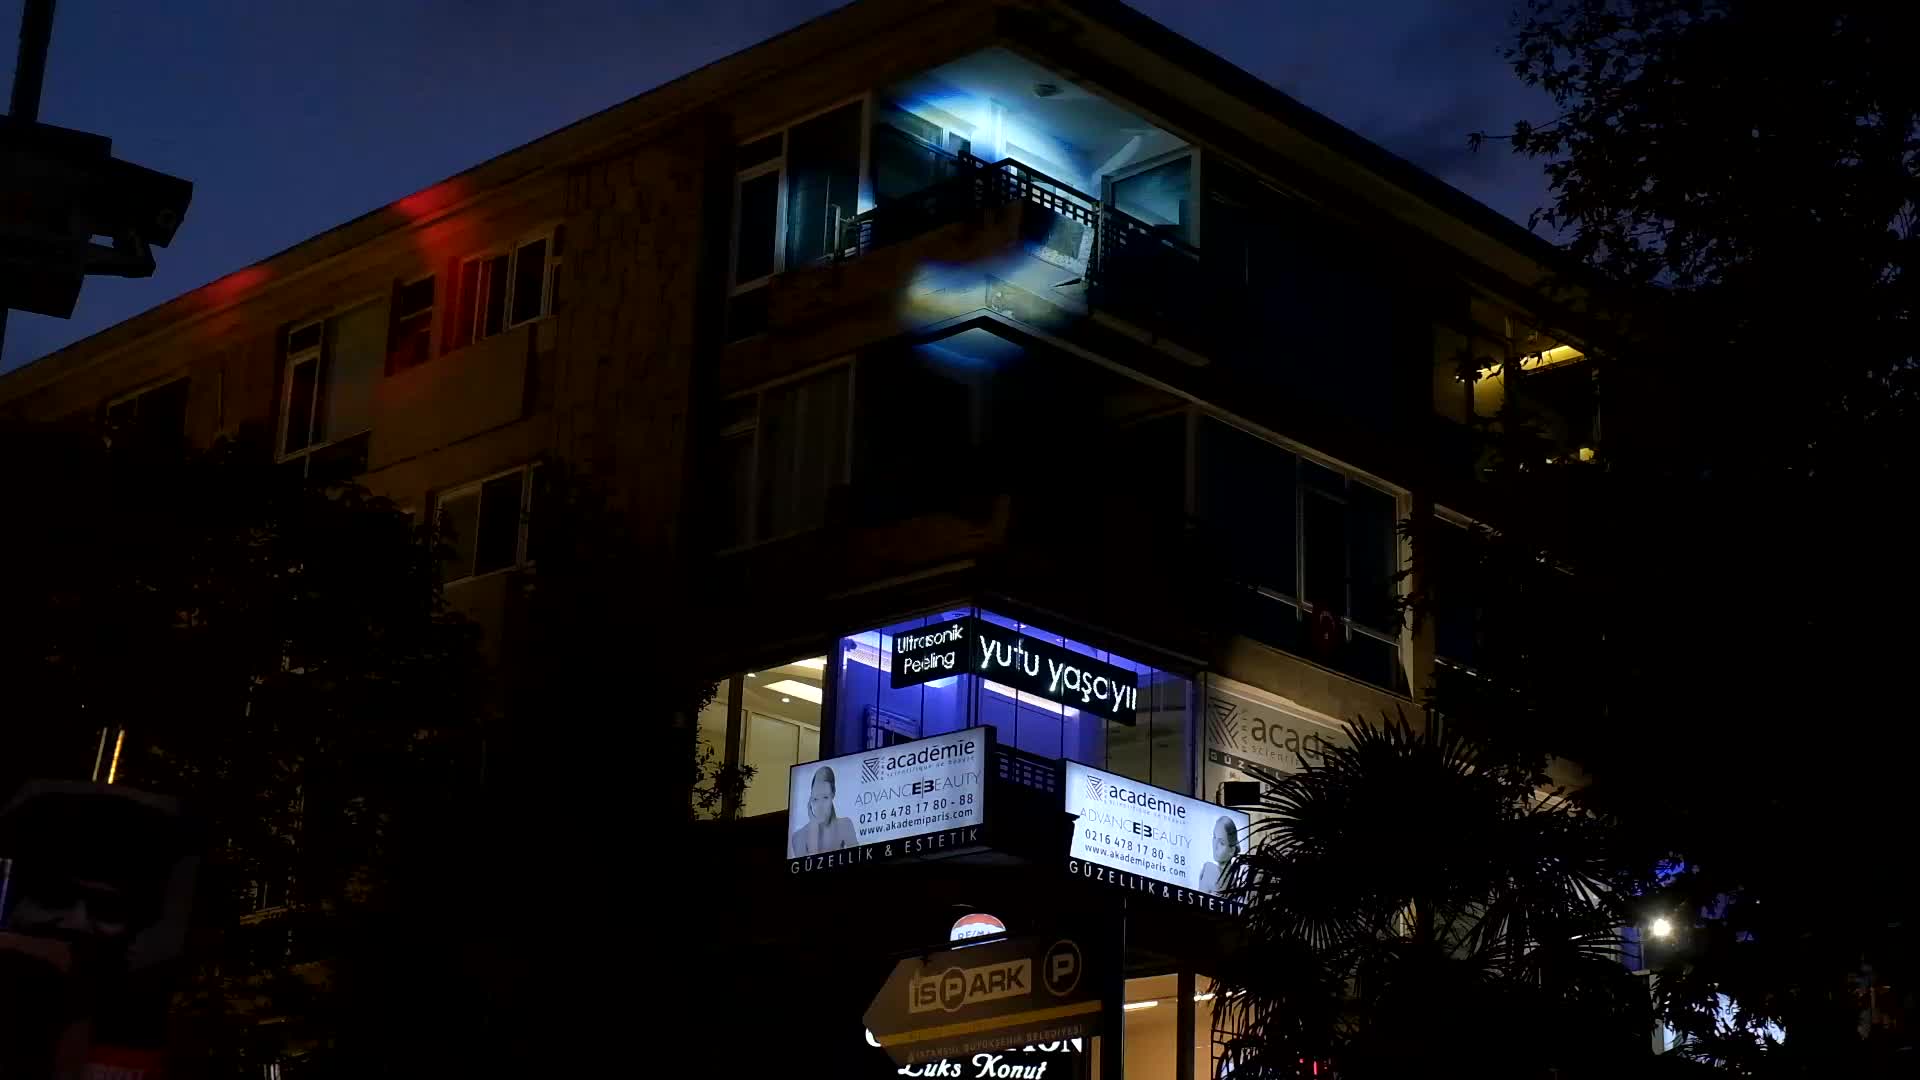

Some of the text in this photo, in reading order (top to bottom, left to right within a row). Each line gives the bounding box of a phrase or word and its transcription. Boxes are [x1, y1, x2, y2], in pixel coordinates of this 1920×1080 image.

[904, 651, 956, 675] Peeling
[859, 808, 886, 824] 0216
[890, 804, 911, 818] 478
[916, 801, 928, 813] 17
[933, 797, 947, 811] 80
[959, 793, 974, 806] 88
[859, 809, 973, 836] www.akademiparis.com
[791, 828, 977, 874] GÜZELLİK & ESTETİK
[1084, 844, 1187, 878] www.akademiparis.com
[1085, 829, 1111, 845] 0216
[1114, 837, 1133, 851] 478
[1137, 843, 1148, 856] 17
[1151, 847, 1164, 860] 80
[1174, 855, 1186, 866] 88
[1162, 885, 1170, 898] &
[971, 1053, 1048, 1080] Konut
